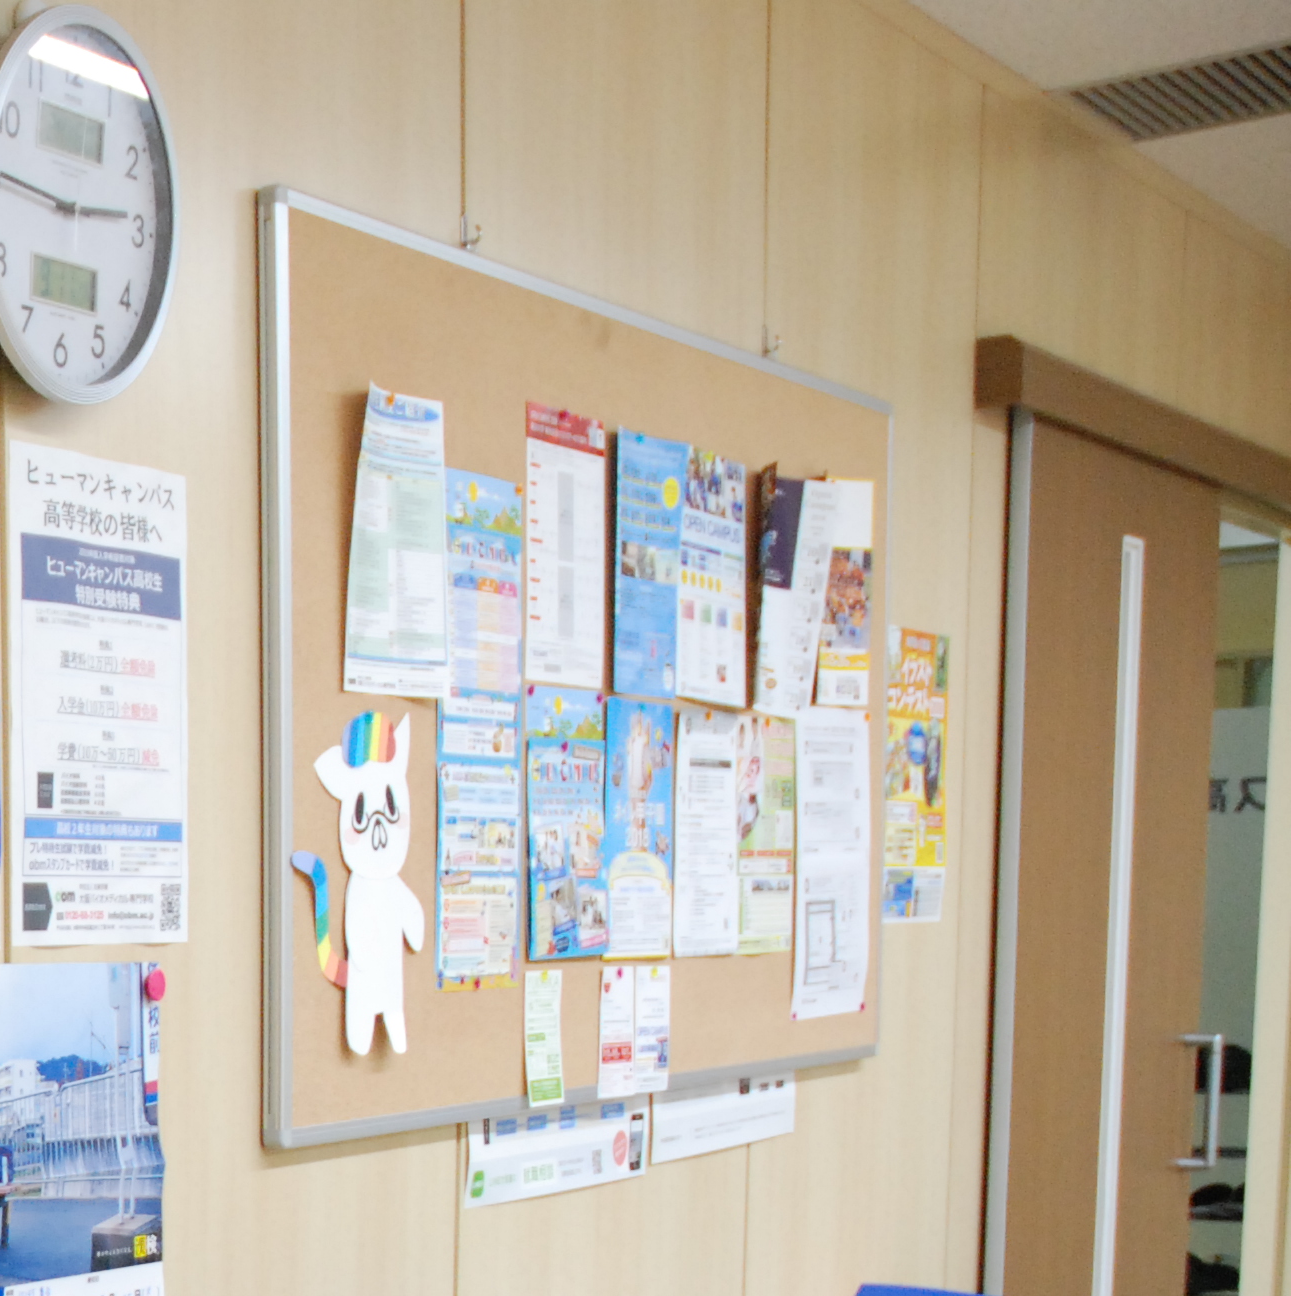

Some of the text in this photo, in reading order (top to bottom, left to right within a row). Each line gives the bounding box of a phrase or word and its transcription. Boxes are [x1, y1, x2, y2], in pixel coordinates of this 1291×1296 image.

[125, 145, 139, 180] 2
[131, 215, 145, 248] 3
[119, 279, 131, 312] 4
[21, 304, 34, 333] 7
[53, 333, 68, 368] 6
[91, 325, 105, 359] 5
[26, 458, 175, 511] ヒューマンキャンパス
[43, 498, 163, 543] 高等学校の皆様へ
